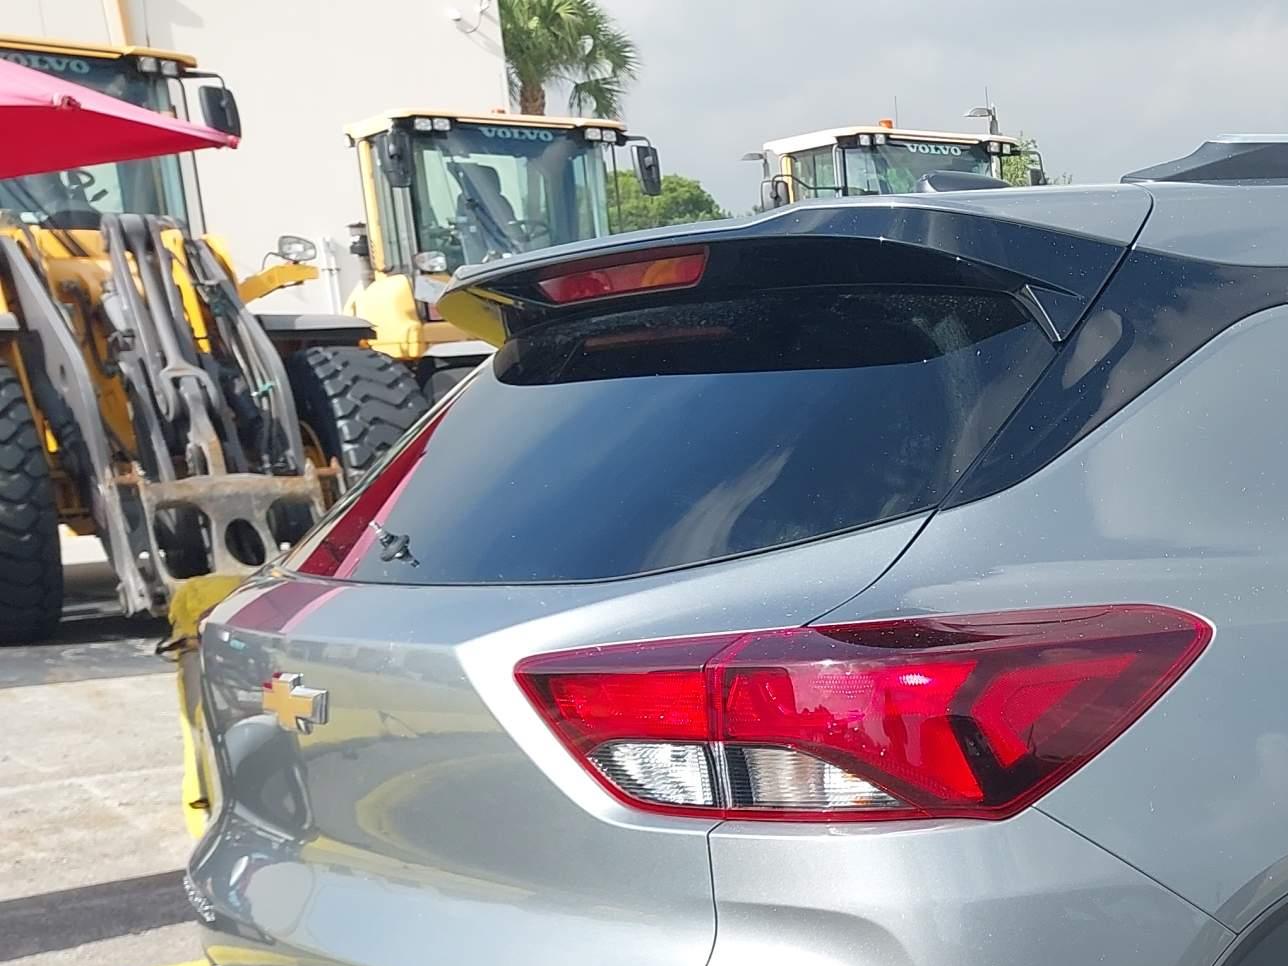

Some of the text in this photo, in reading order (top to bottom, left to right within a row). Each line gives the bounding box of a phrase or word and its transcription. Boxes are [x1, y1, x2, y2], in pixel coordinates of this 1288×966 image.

[0, 51, 91, 75] OLVO
[478, 126, 554, 142] VOLVO
[904, 143, 962, 157] VOLVO
